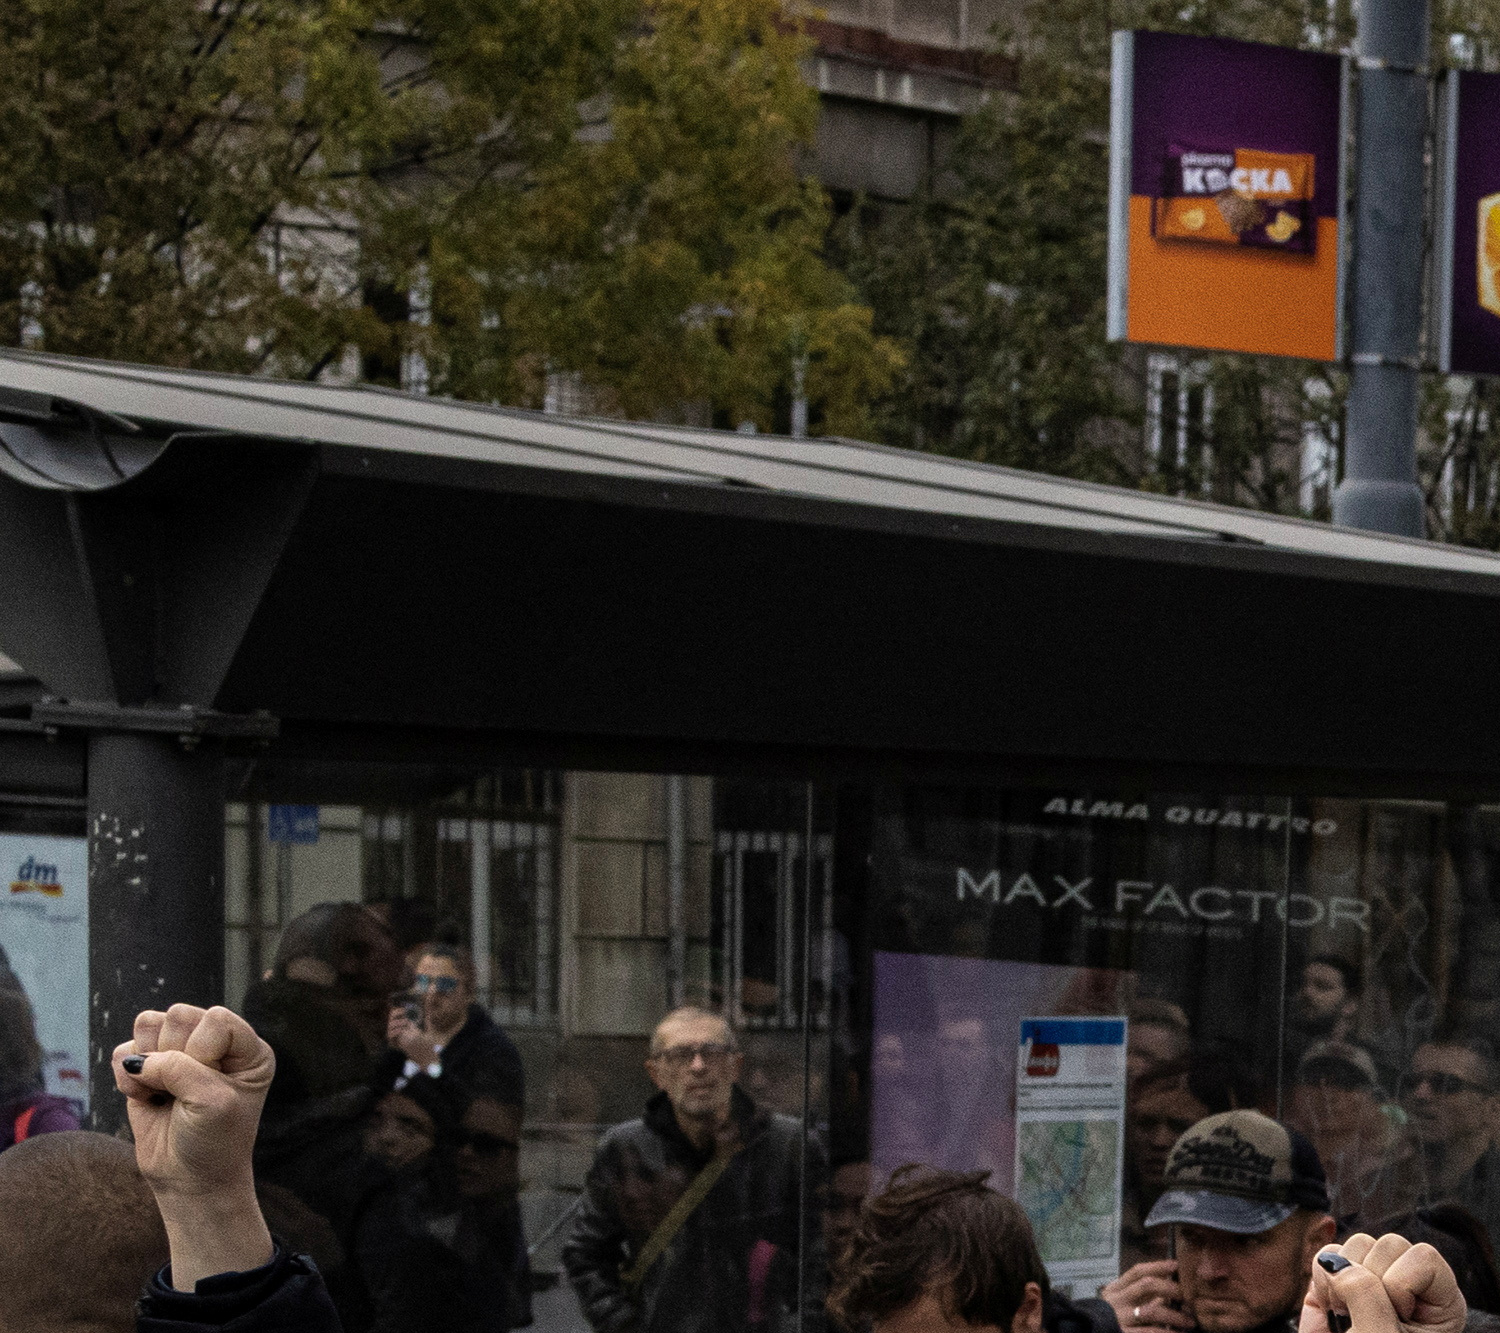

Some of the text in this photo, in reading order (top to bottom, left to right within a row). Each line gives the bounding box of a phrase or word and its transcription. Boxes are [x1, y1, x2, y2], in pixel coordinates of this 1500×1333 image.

[1043, 798, 1338, 836] ALMA QUATTRO
[18, 855, 57, 884] dm
[956, 867, 1093, 911] MAX
[1114, 880, 1371, 932] FACTOR
